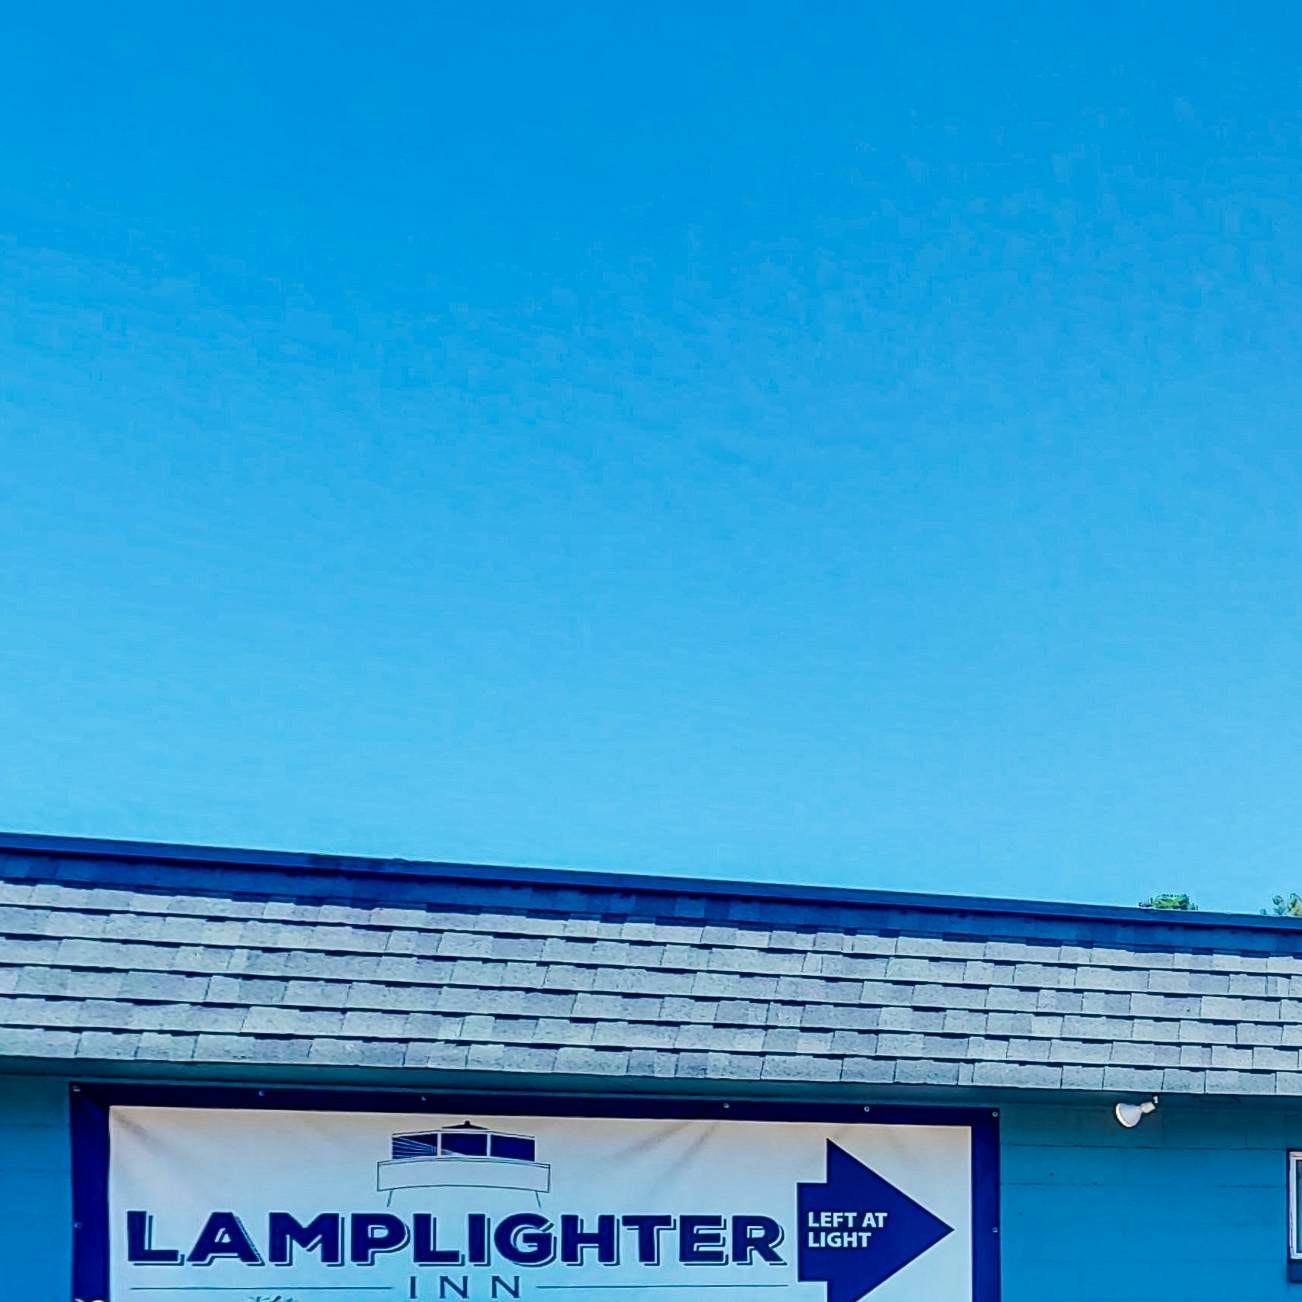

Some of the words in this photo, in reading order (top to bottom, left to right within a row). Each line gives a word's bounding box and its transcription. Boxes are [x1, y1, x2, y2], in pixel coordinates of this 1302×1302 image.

[808, 1211, 858, 1228] LEFT
[862, 1212, 888, 1228] AT
[126, 1210, 787, 1268] LAMPLIGHTER
[808, 1231, 872, 1248] LIGHT
[408, 1275, 521, 1300] INN
